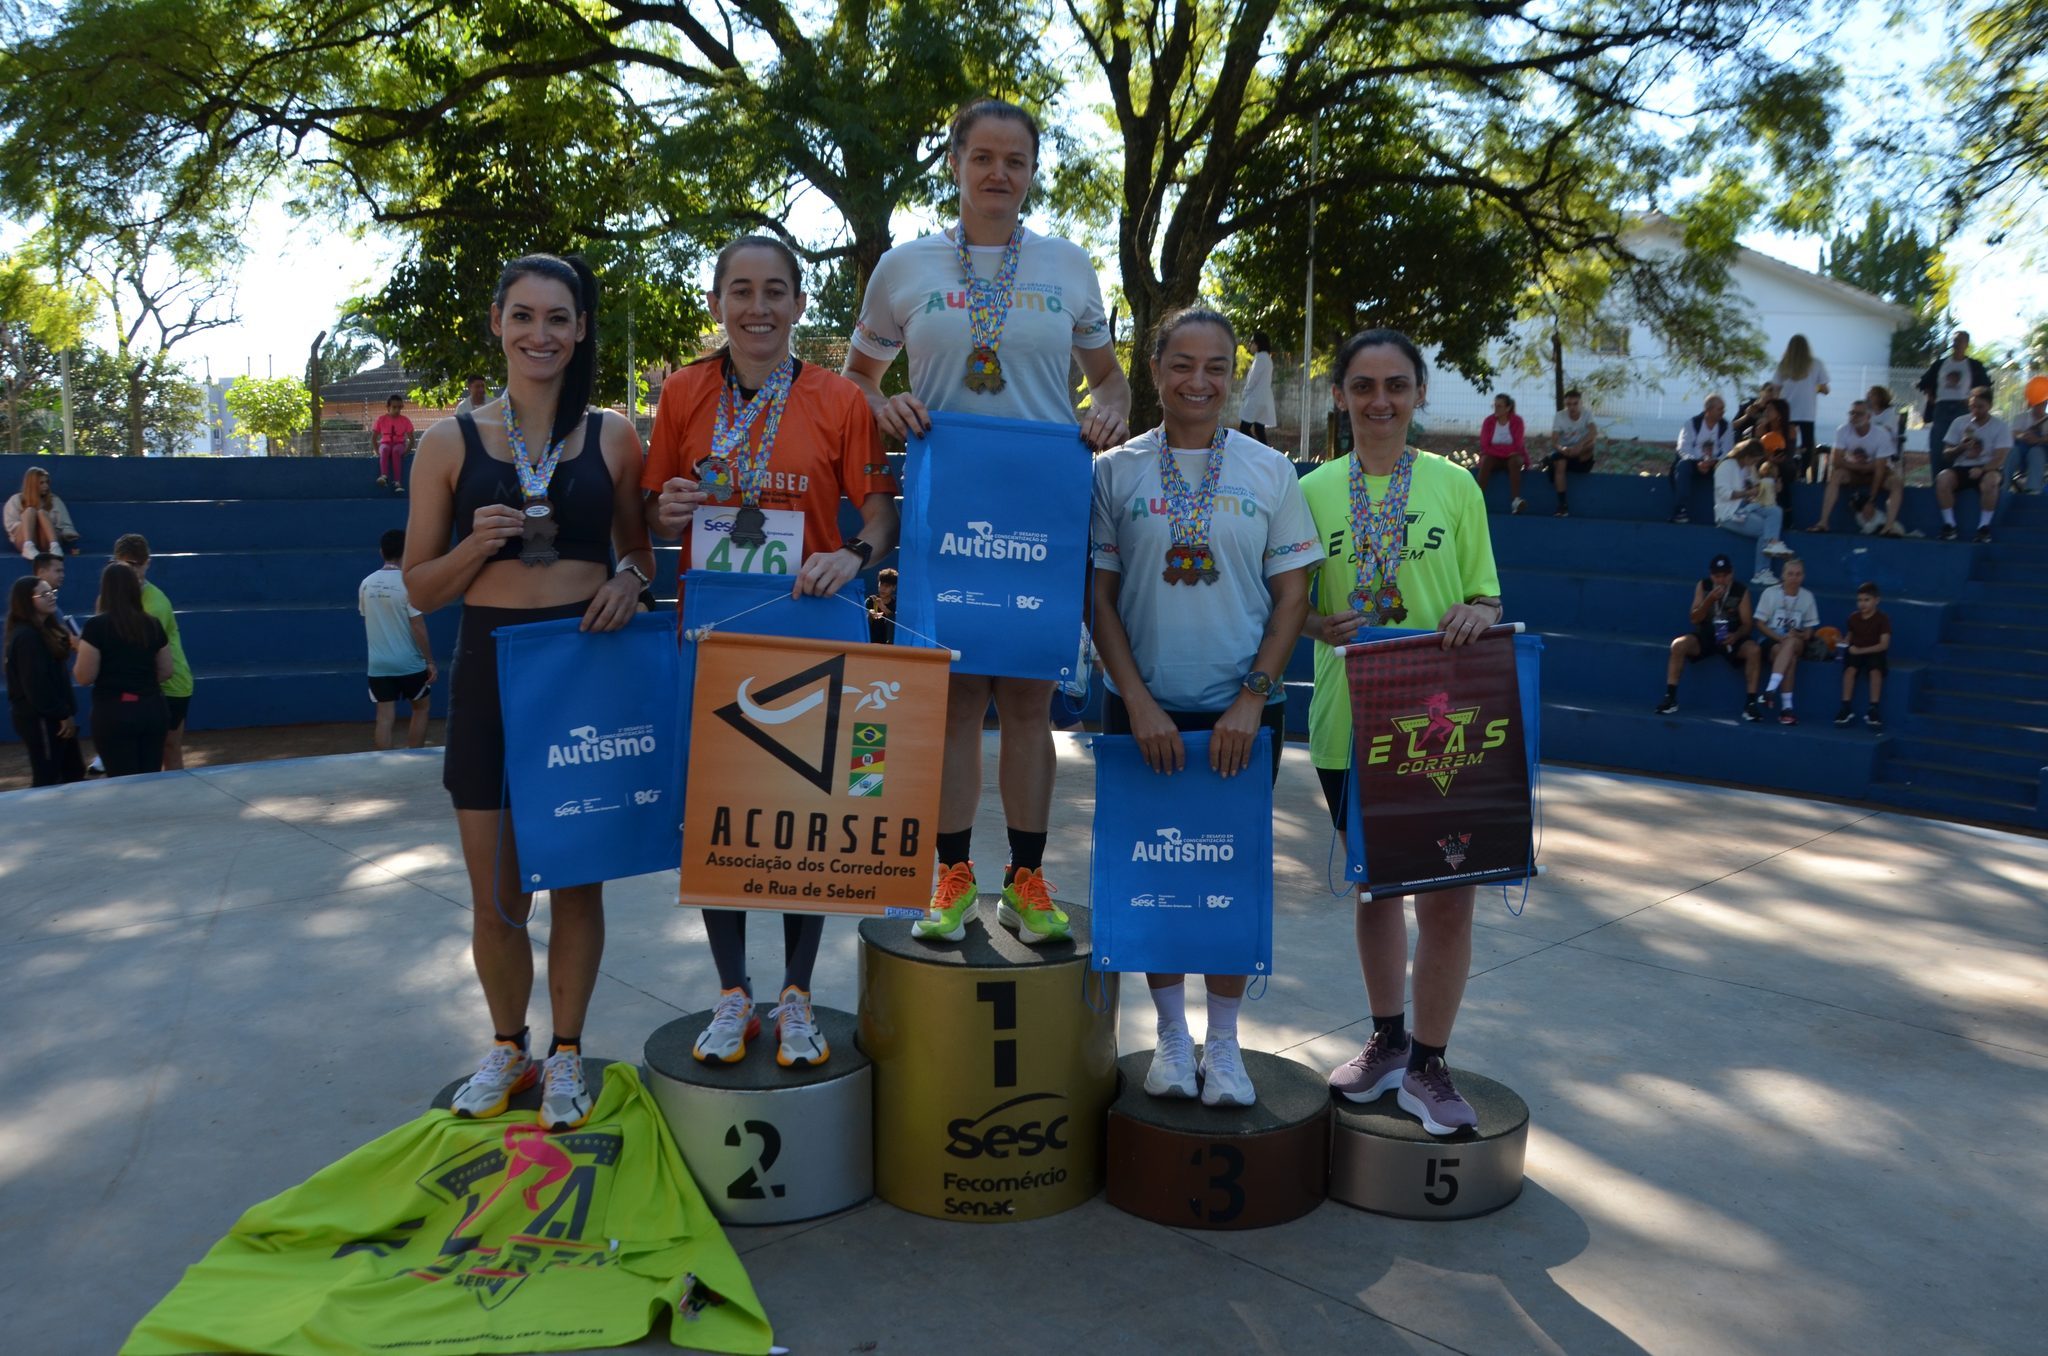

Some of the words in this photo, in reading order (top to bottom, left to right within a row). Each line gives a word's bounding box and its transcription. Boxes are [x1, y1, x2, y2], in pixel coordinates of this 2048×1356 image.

[924, 290, 1062, 314] Aumo
[1131, 496, 1257, 521] Aumo
[706, 537, 787, 574] 476
[939, 532, 1047, 561] Autismo
[547, 735, 656, 769] Autismo
[1367, 718, 1510, 765] ELAS
[1396, 752, 1485, 775] CORREM
[710, 806, 920, 857] ACORSEB
[705, 851, 792, 873] Associação
[797, 857, 825, 873] dos
[830, 858, 916, 878] Corredores
[1131, 841, 1234, 862] Autismo
[743, 879, 763, 894] de
[768, 881, 797, 896] Rua
[802, 882, 822, 897] de
[827, 884, 876, 900] Seberi
[976, 981, 1017, 1088] 1
[944, 1112, 1069, 1160] Sesc
[724, 1119, 786, 1199] 2
[943, 1166, 1067, 1193] Fecomércio
[1190, 1143, 1245, 1223] 3
[1424, 1158, 1460, 1206] 5
[944, 1197, 1016, 1217] Senac
